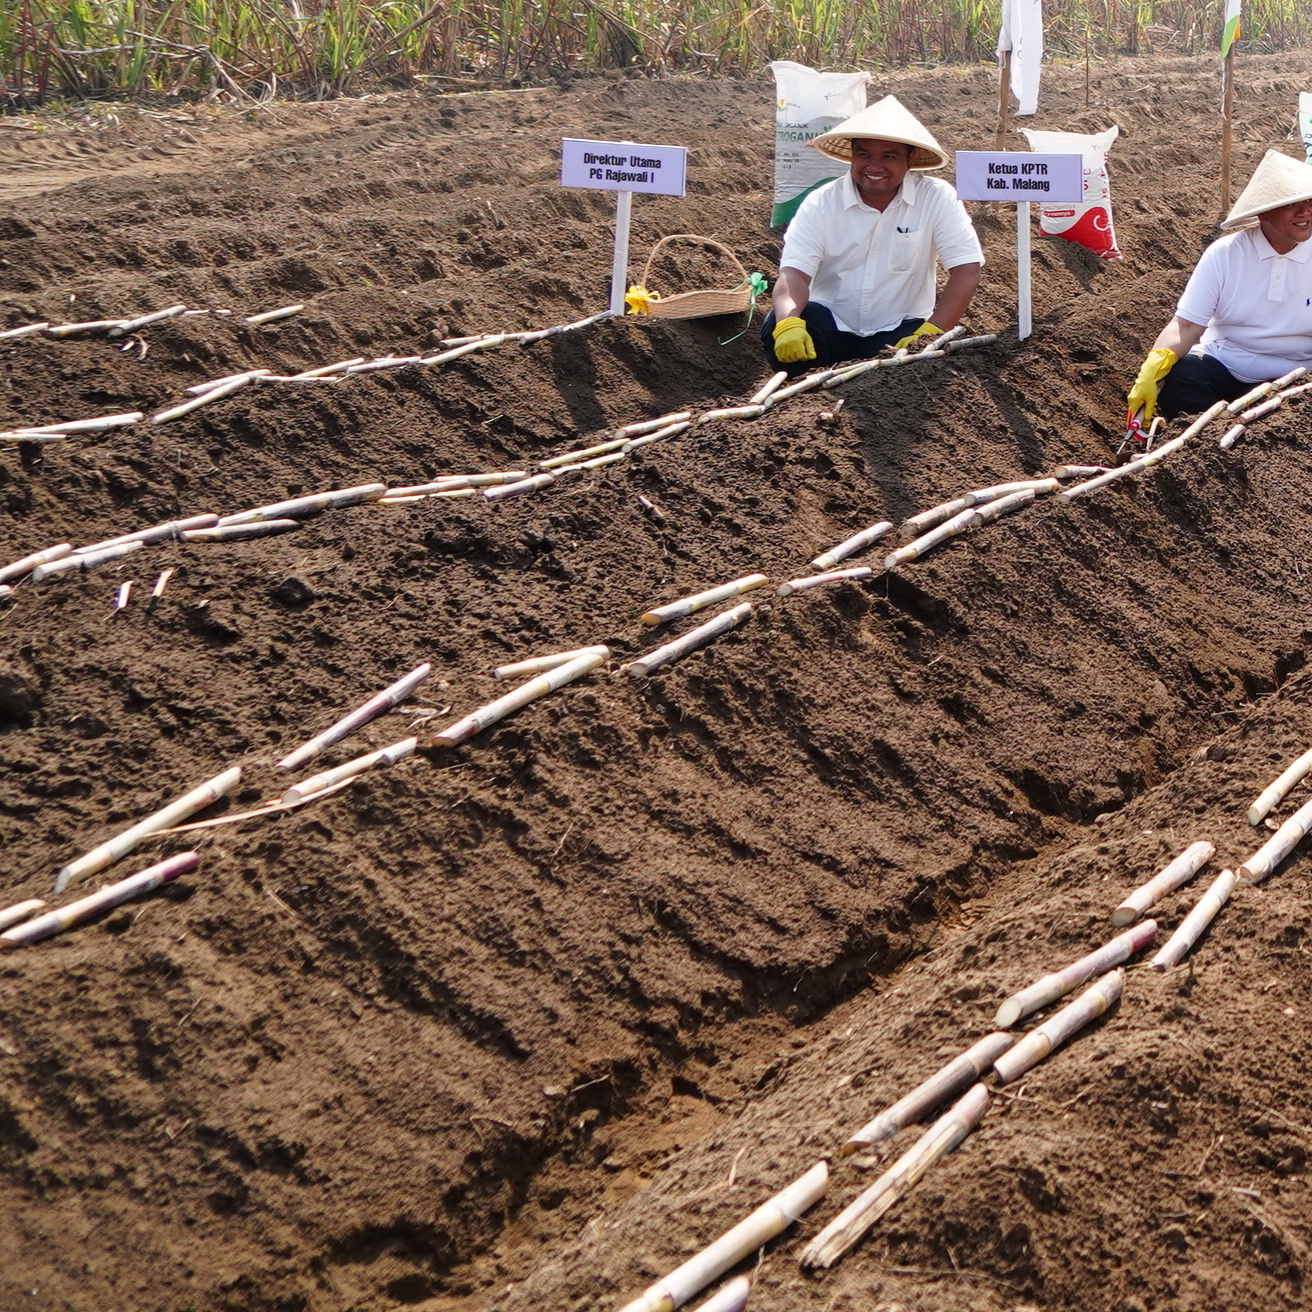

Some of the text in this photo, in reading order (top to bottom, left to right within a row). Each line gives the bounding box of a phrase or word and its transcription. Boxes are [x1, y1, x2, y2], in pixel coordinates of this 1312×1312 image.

[584, 152, 661, 169] Direktur Utama
[590, 168, 603, 180] PG
[605, 169, 648, 184] Rajawali
[988, 162, 1048, 175] Ketua KPTR
[987, 178, 1050, 192] Kab. Malang
